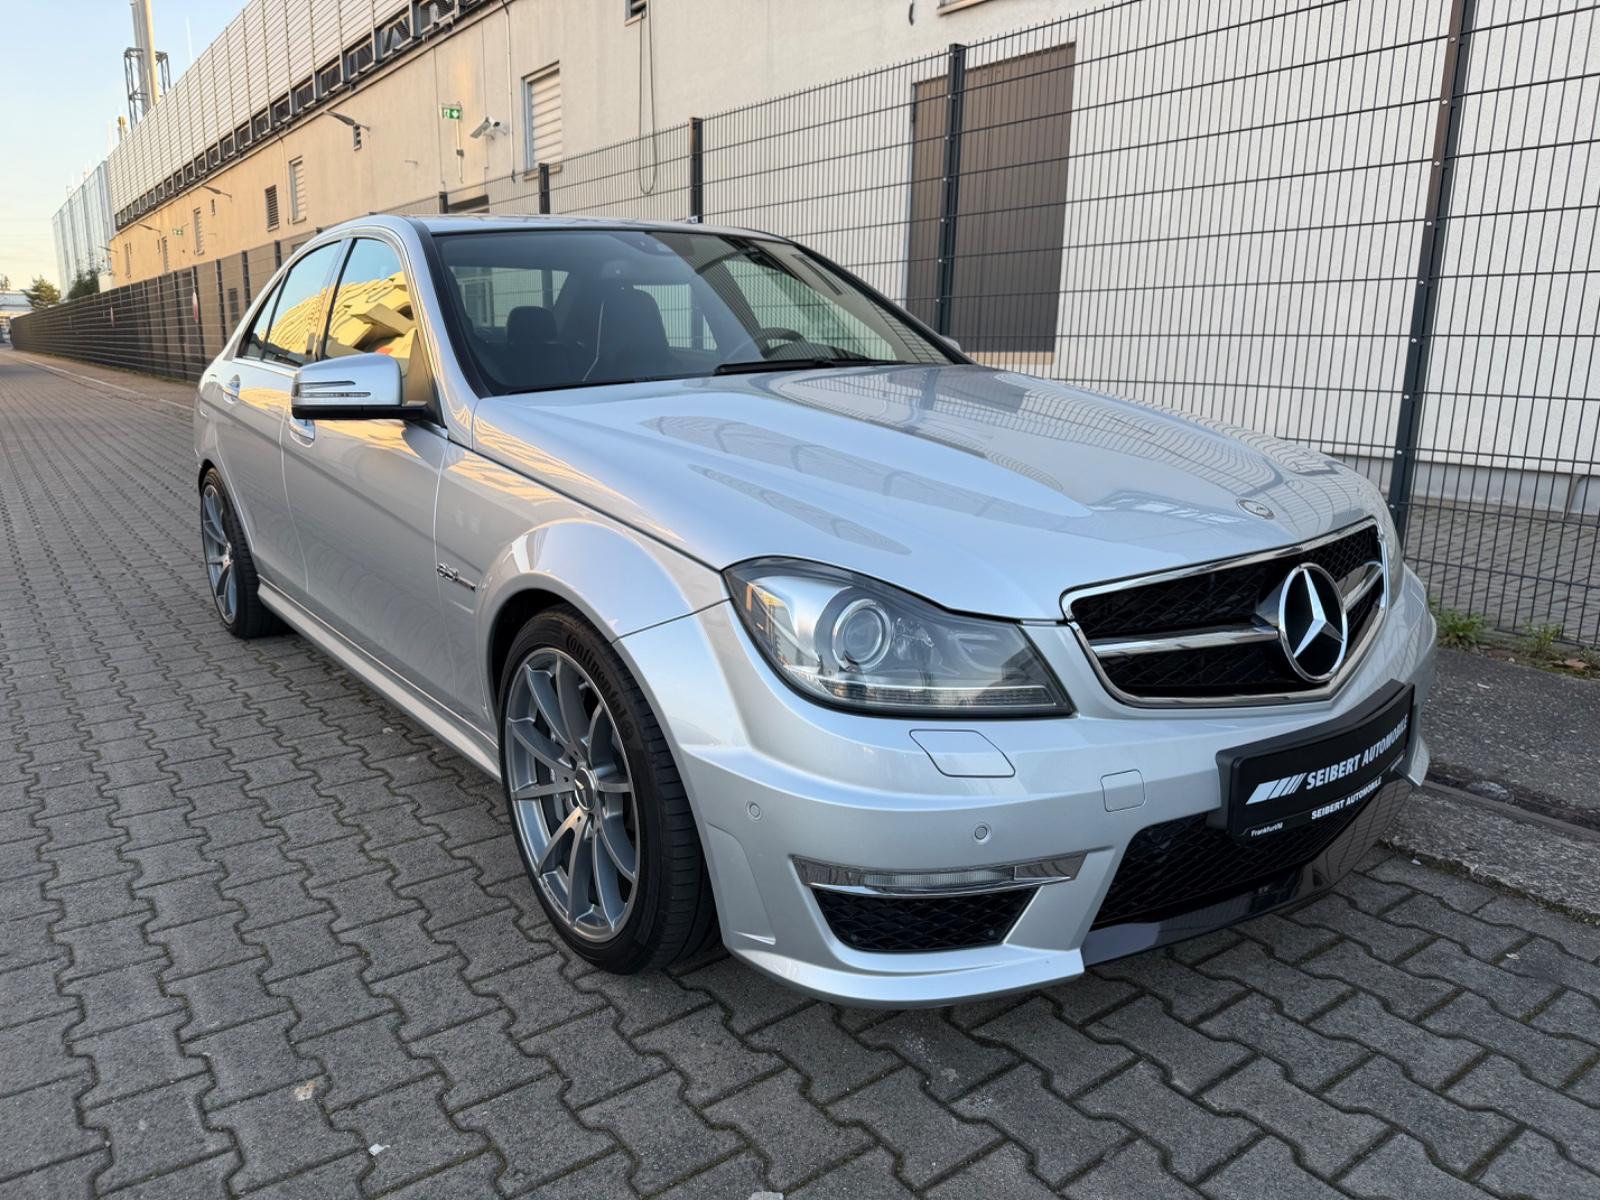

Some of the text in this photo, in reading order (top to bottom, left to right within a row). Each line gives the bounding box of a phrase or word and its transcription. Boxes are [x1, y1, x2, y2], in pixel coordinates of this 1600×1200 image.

[1306, 713, 1408, 790] SEIBERT AUTOMOBILE
[1311, 799, 1345, 820] SEIBERT
